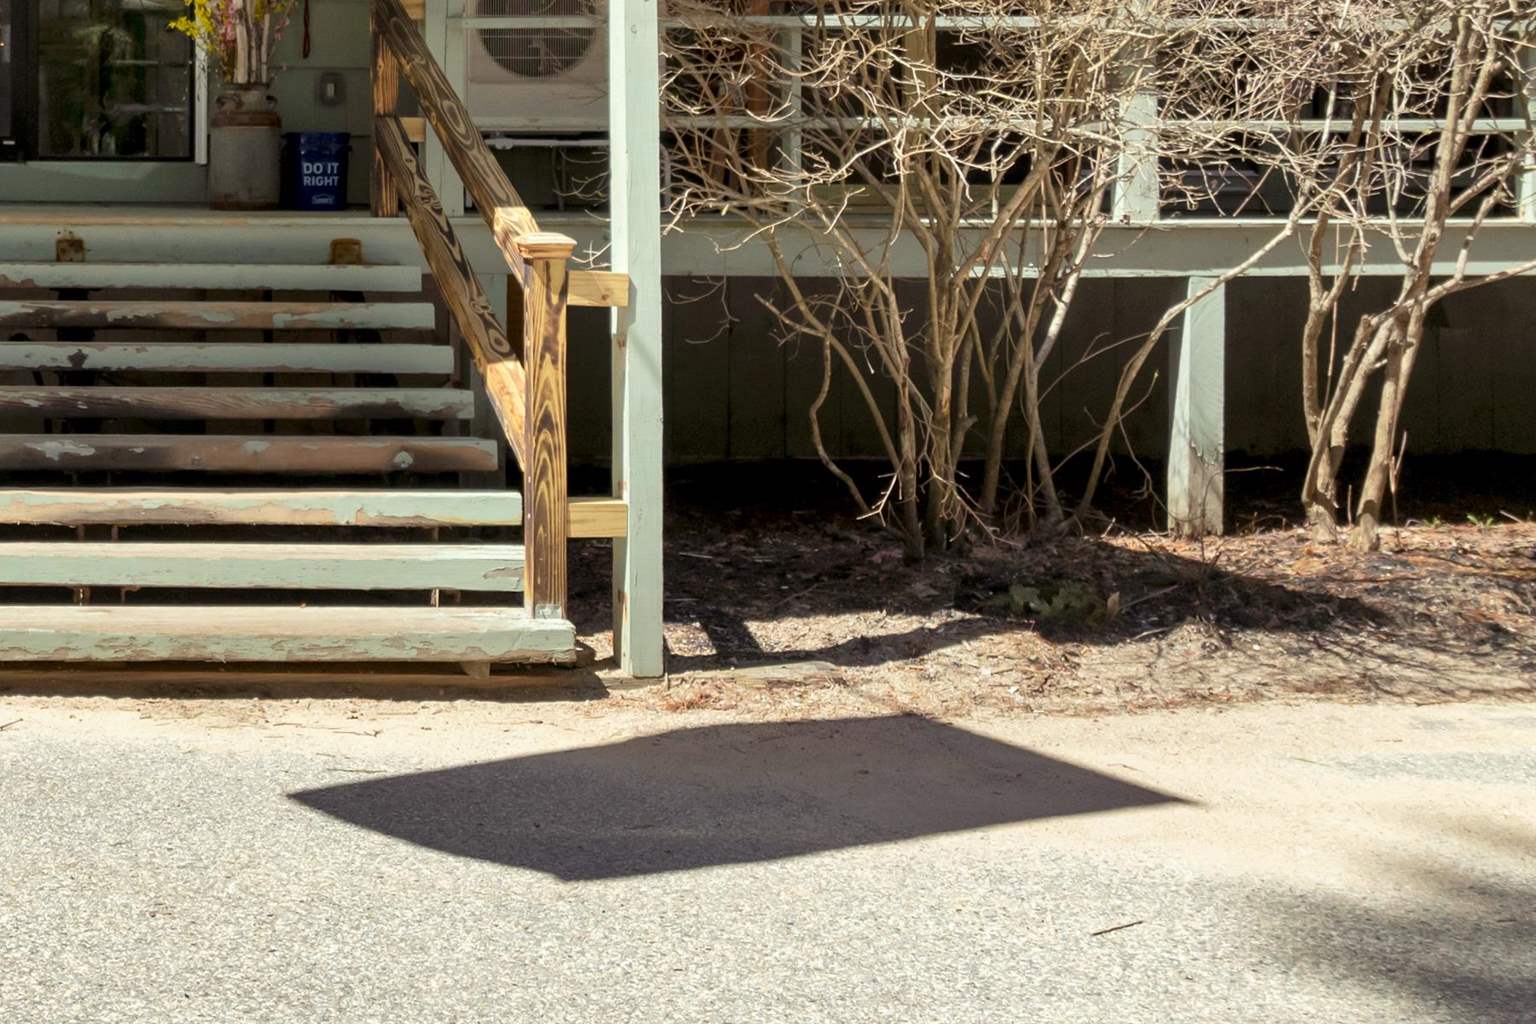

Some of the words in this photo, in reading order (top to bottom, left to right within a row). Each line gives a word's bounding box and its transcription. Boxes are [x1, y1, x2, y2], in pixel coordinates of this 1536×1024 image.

[304, 162, 324, 174] DO
[327, 162, 340, 174] IT
[303, 176, 340, 186] RIGHT
